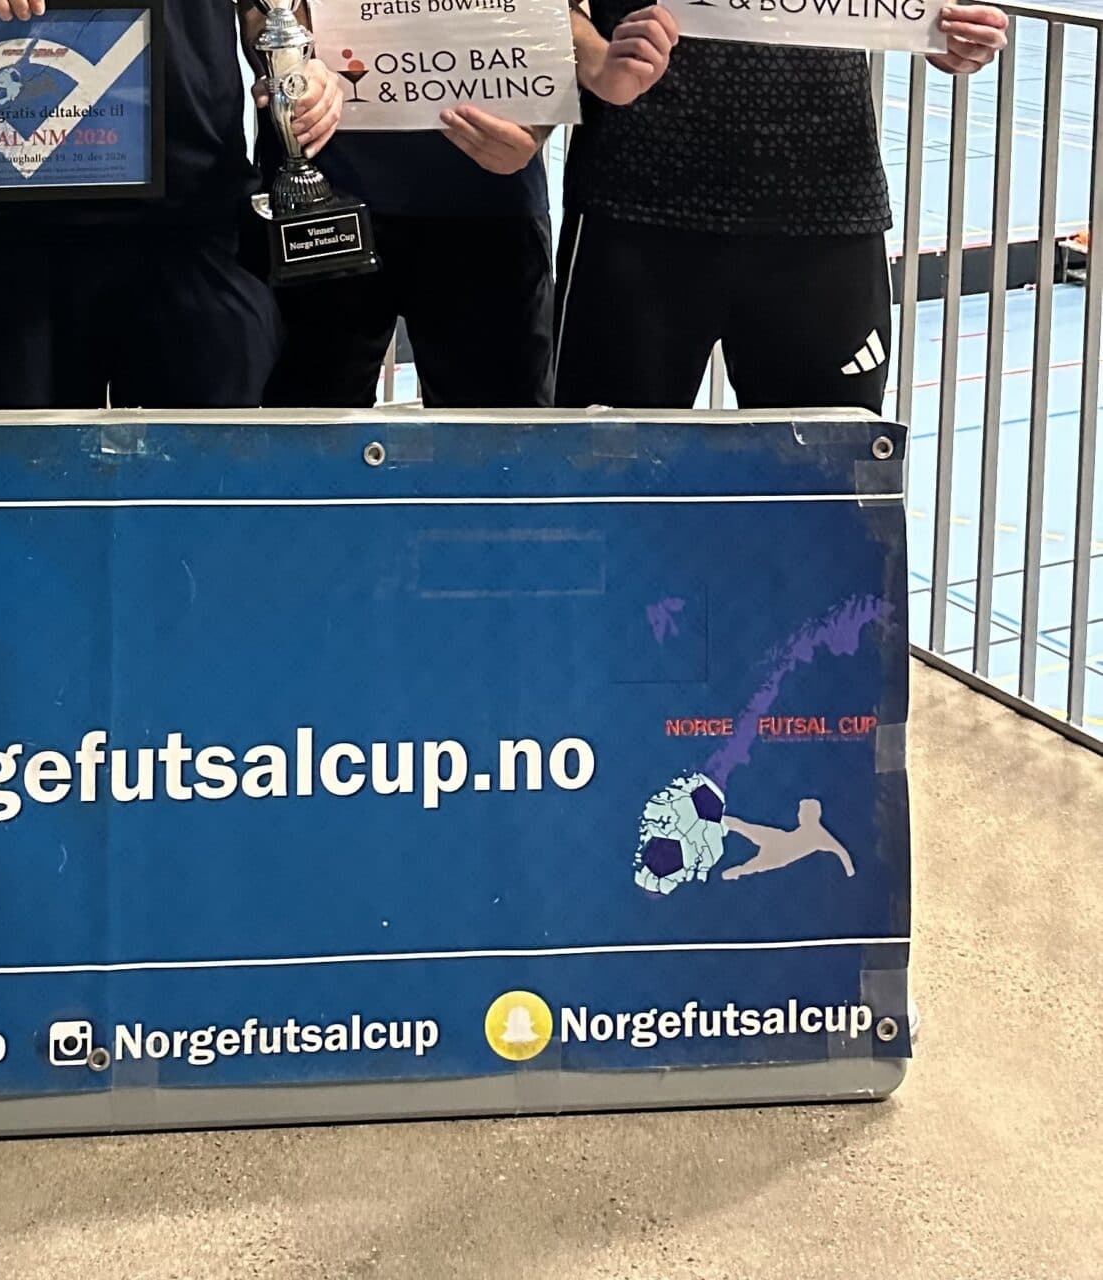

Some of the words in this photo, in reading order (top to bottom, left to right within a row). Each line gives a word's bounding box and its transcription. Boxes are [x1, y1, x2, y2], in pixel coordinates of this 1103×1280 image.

[374, 50, 456, 74] OSLO
[470, 47, 528, 70] BAR
[40, 104, 106, 119] deltakelse
[110, 104, 124, 117] til
[32, 128, 66, 146] NM
[74, 127, 119, 144] 2026
[307, 226, 334, 236] Vinner
[289, 241, 314, 251] Norge
[314, 235, 339, 246] Futsal
[339, 233, 355, 243] Cup
[665, 717, 734, 737] NORGE
[758, 716, 833, 736] FUTSAL
[838, 716, 878, 735] CUP
[560, 997, 874, 1049] Norgefutsalcup
[114, 1012, 439, 1067] Norgefutsalcup
